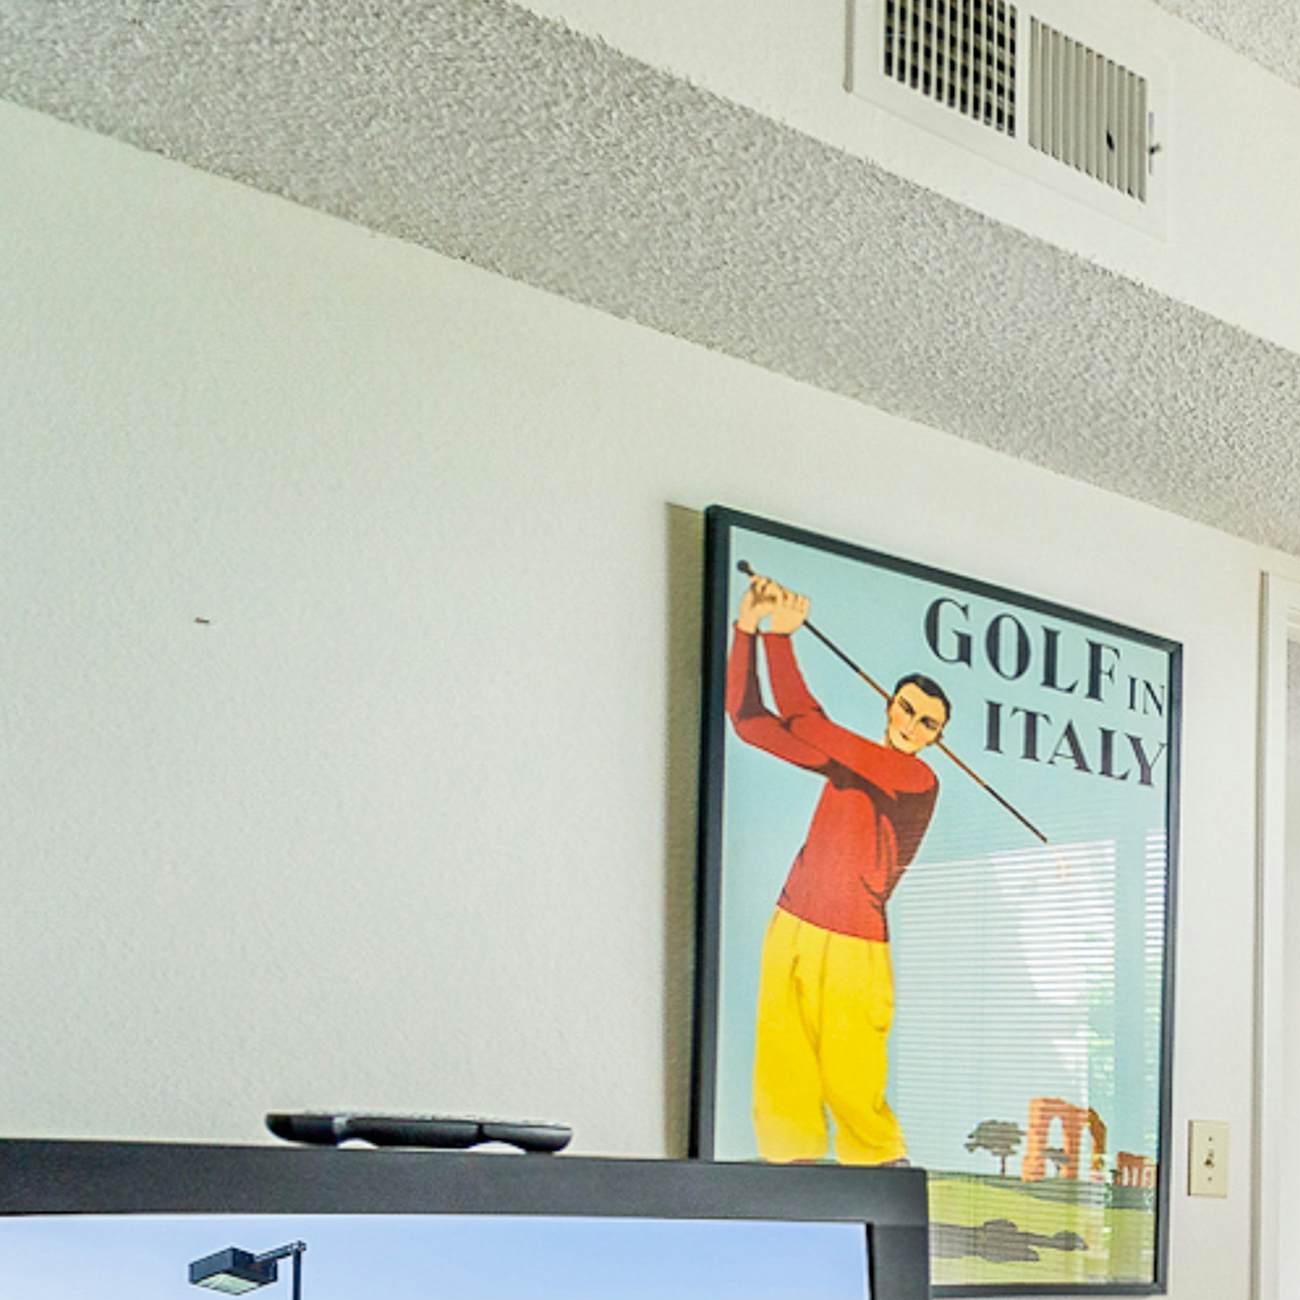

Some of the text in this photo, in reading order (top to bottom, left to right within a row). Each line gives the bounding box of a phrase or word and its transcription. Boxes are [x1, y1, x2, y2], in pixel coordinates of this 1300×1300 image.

[924, 597, 1165, 717] GOLF IN
[983, 699, 1167, 788] ITALY
